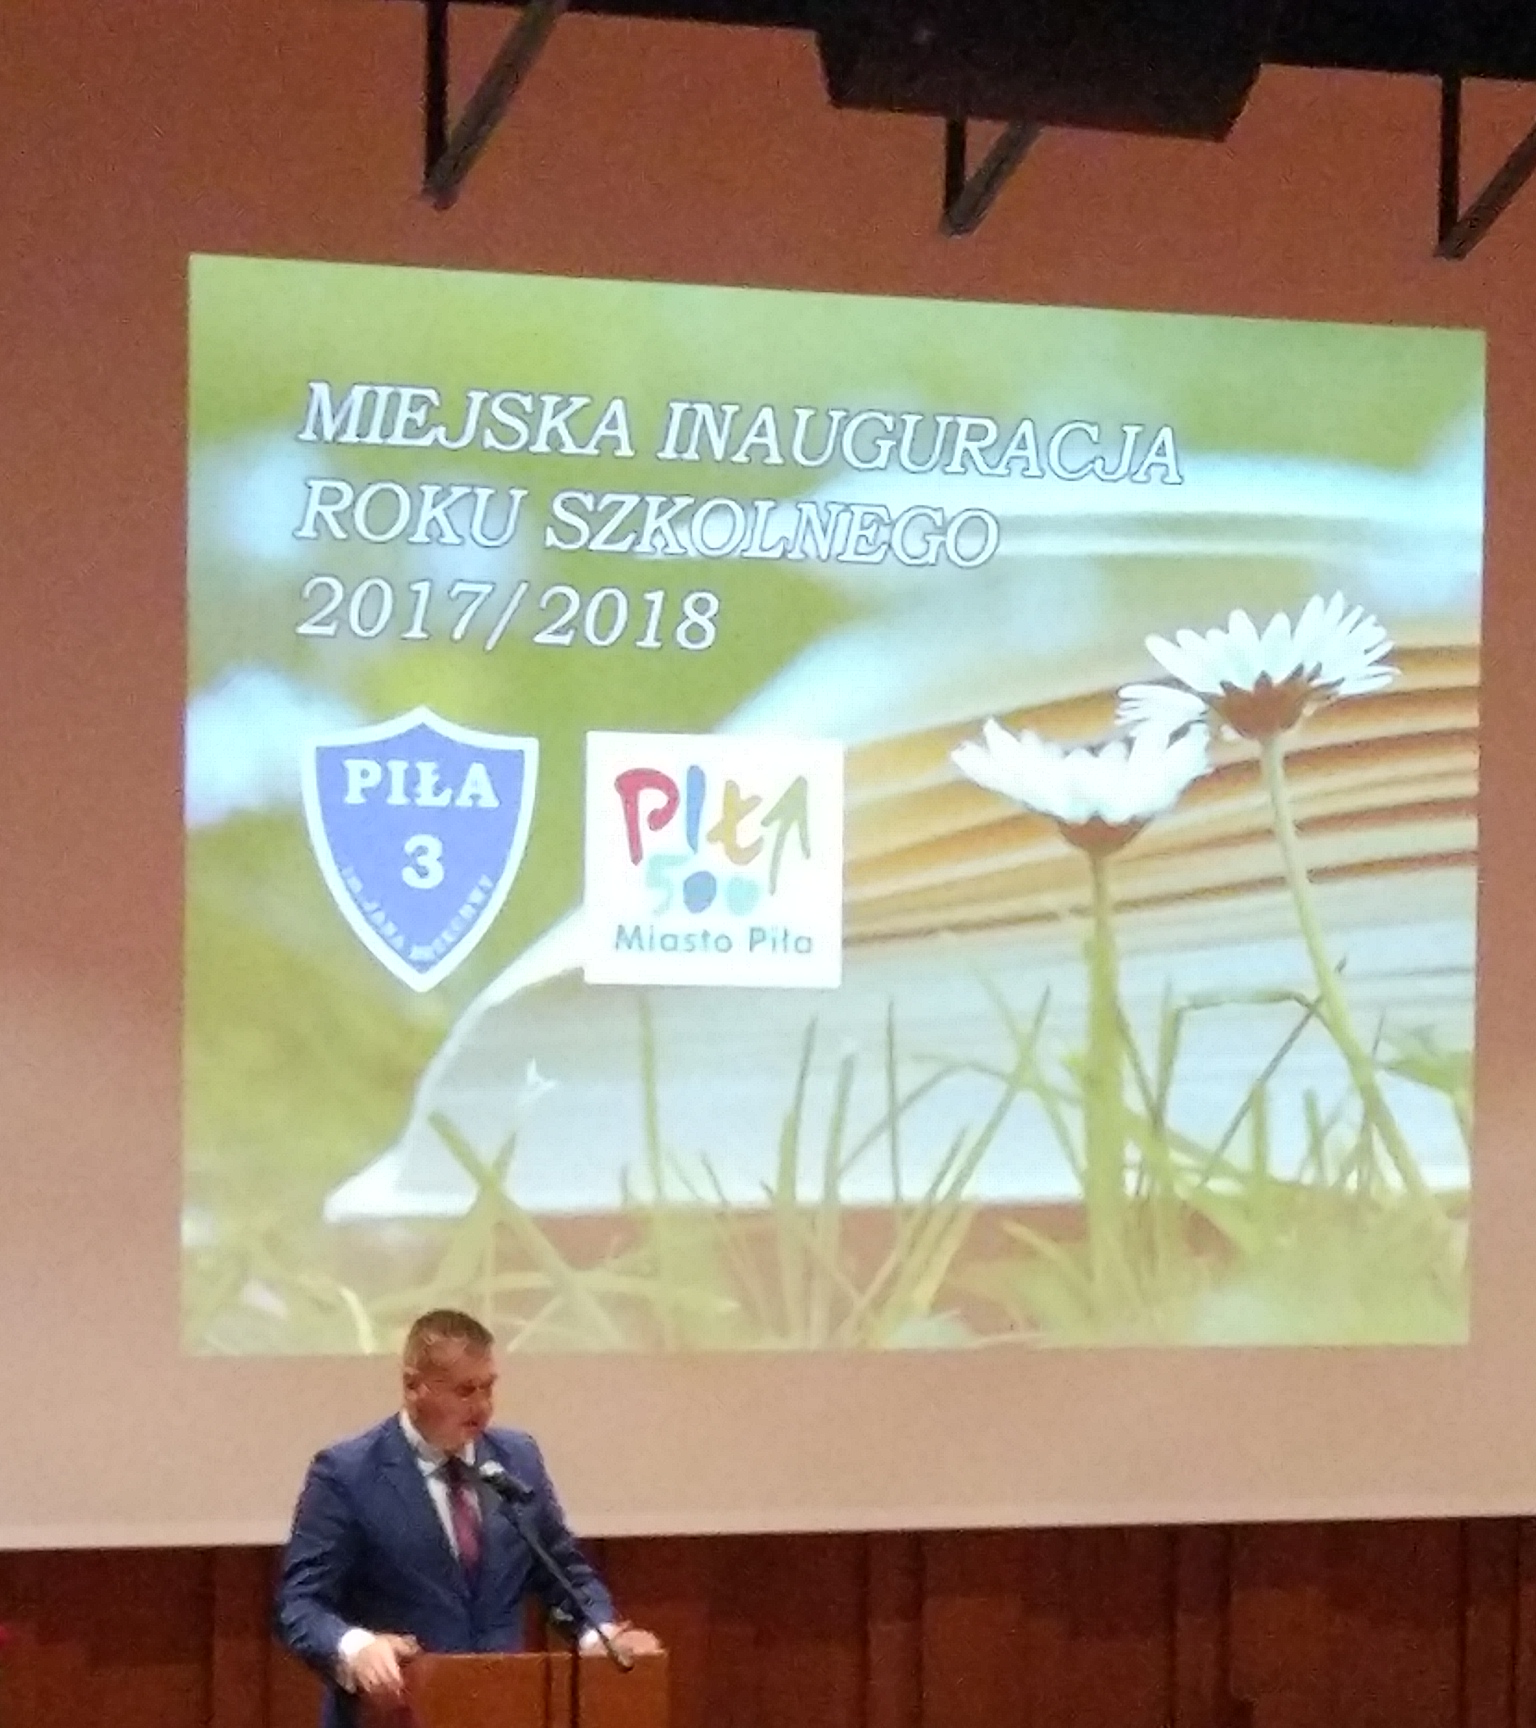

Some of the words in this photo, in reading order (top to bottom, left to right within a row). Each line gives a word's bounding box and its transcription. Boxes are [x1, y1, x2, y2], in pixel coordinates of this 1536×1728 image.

[297, 381, 636, 459] MIEJSKA
[655, 400, 1184, 486] INAUGURACJA
[293, 477, 529, 549] ROKU
[543, 489, 1001, 568] SZKOLNEGO
[295, 573, 721, 653] 2017/2018
[342, 758, 500, 809] PIŁA
[401, 834, 445, 890] 3
[615, 924, 733, 953] Miasto
